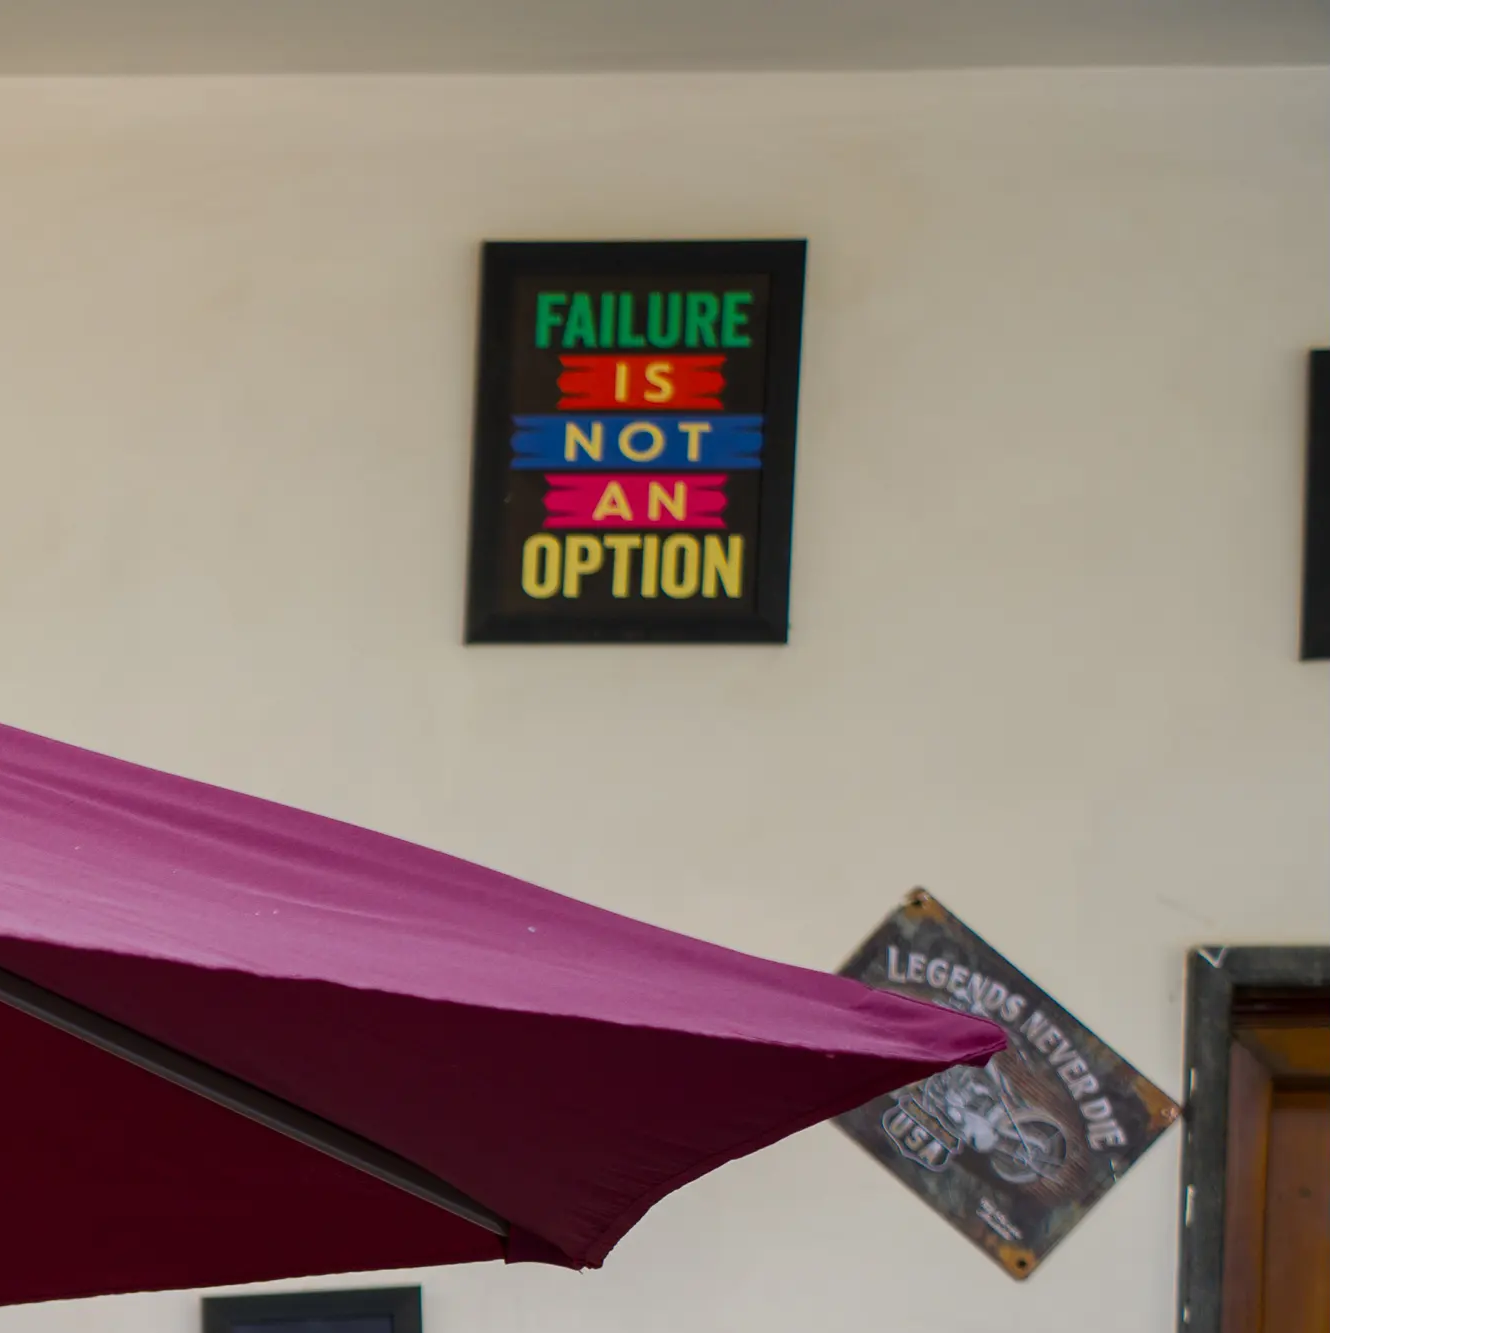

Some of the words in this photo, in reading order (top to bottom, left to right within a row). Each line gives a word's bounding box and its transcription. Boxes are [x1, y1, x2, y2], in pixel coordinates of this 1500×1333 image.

[534, 291, 754, 349] FAILURE
[614, 361, 675, 404] IS
[563, 421, 712, 462] NOT
[591, 481, 687, 522] AN
[521, 532, 744, 599] OPTION
[886, 945, 1027, 1023] LEGENDS
[1019, 1009, 1101, 1102] NEVER
[1077, 1098, 1129, 1152] DIE
[889, 1114, 951, 1167] USA
